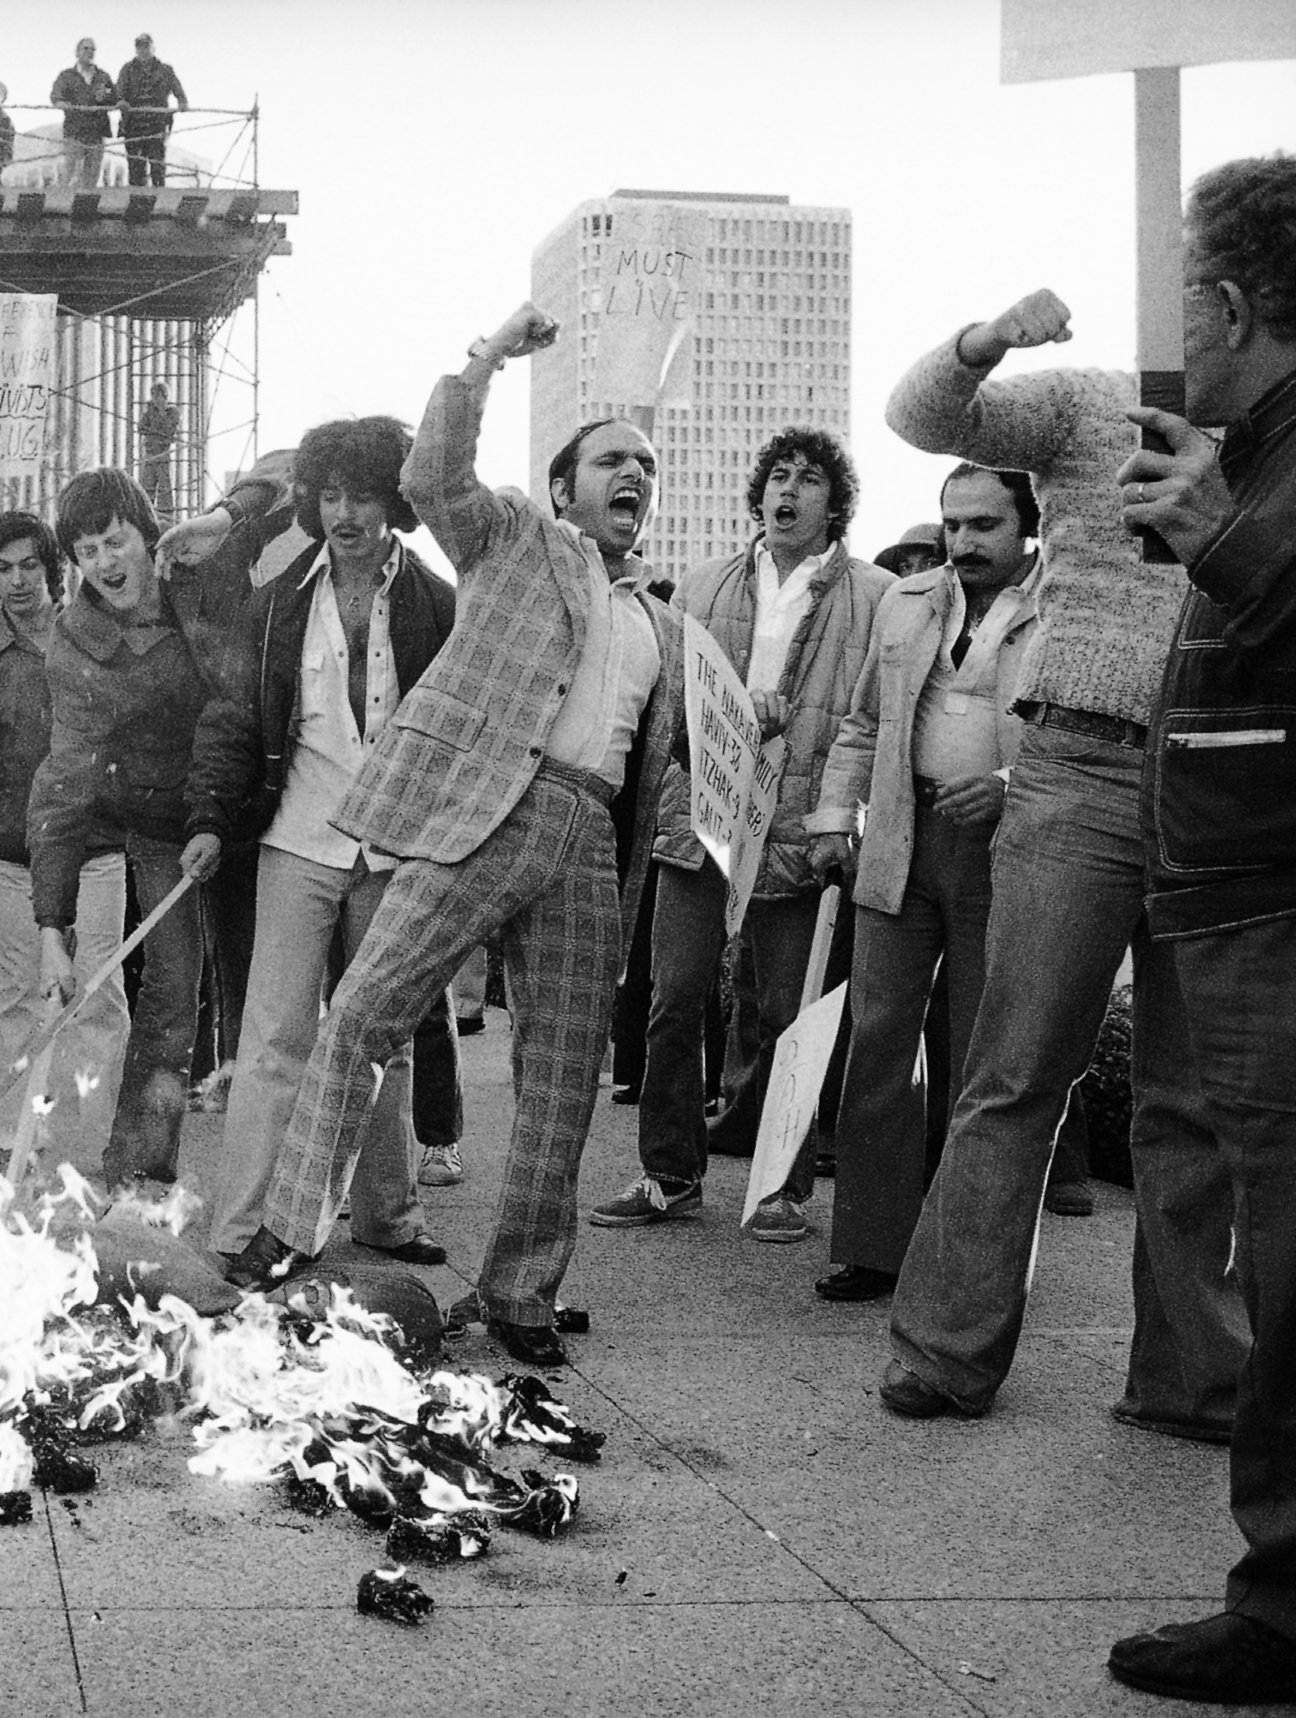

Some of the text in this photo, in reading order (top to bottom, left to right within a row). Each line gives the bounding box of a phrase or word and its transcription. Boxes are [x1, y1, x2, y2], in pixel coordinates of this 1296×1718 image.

[617, 249, 694, 280] MUST
[606, 278, 689, 321] LIVE
[697, 652, 718, 697] THE
